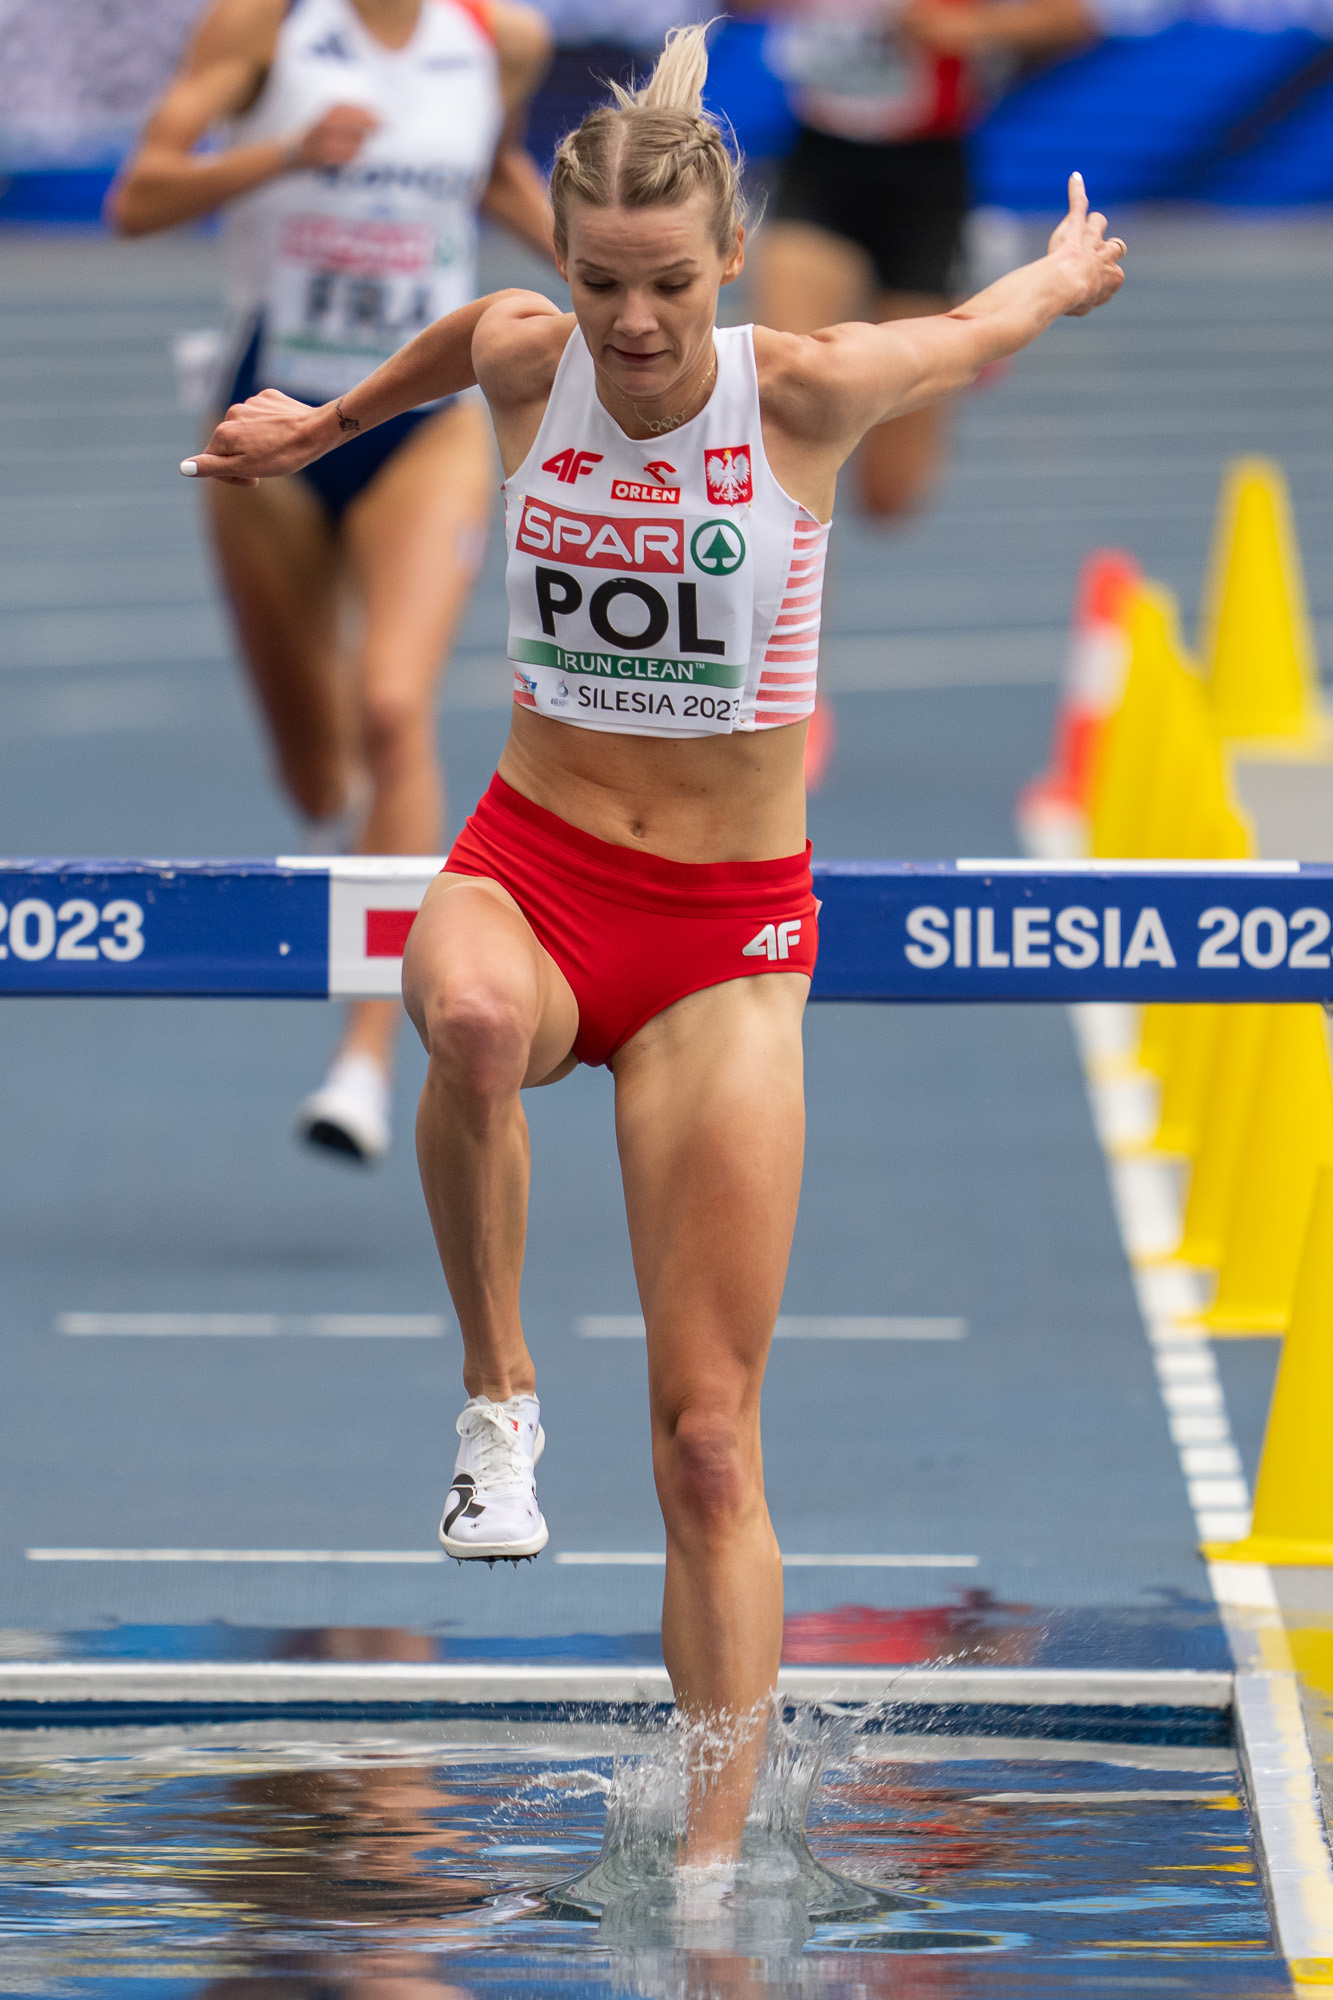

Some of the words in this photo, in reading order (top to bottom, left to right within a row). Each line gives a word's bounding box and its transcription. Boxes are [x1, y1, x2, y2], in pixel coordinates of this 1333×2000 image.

[541, 447, 604, 484] 4F
[615, 483, 677, 502] ORLEN
[520, 505, 679, 566] SPAR
[535, 565, 725, 656] POL
[556, 649, 562, 666] I
[564, 652, 612, 675] RUN
[578, 685, 676, 716] SILESIA
[0, 898, 145, 962] 023
[741, 919, 802, 961] 4F
[904, 906, 1177, 970] SILESIA
[1197, 906, 1333, 970] 202
